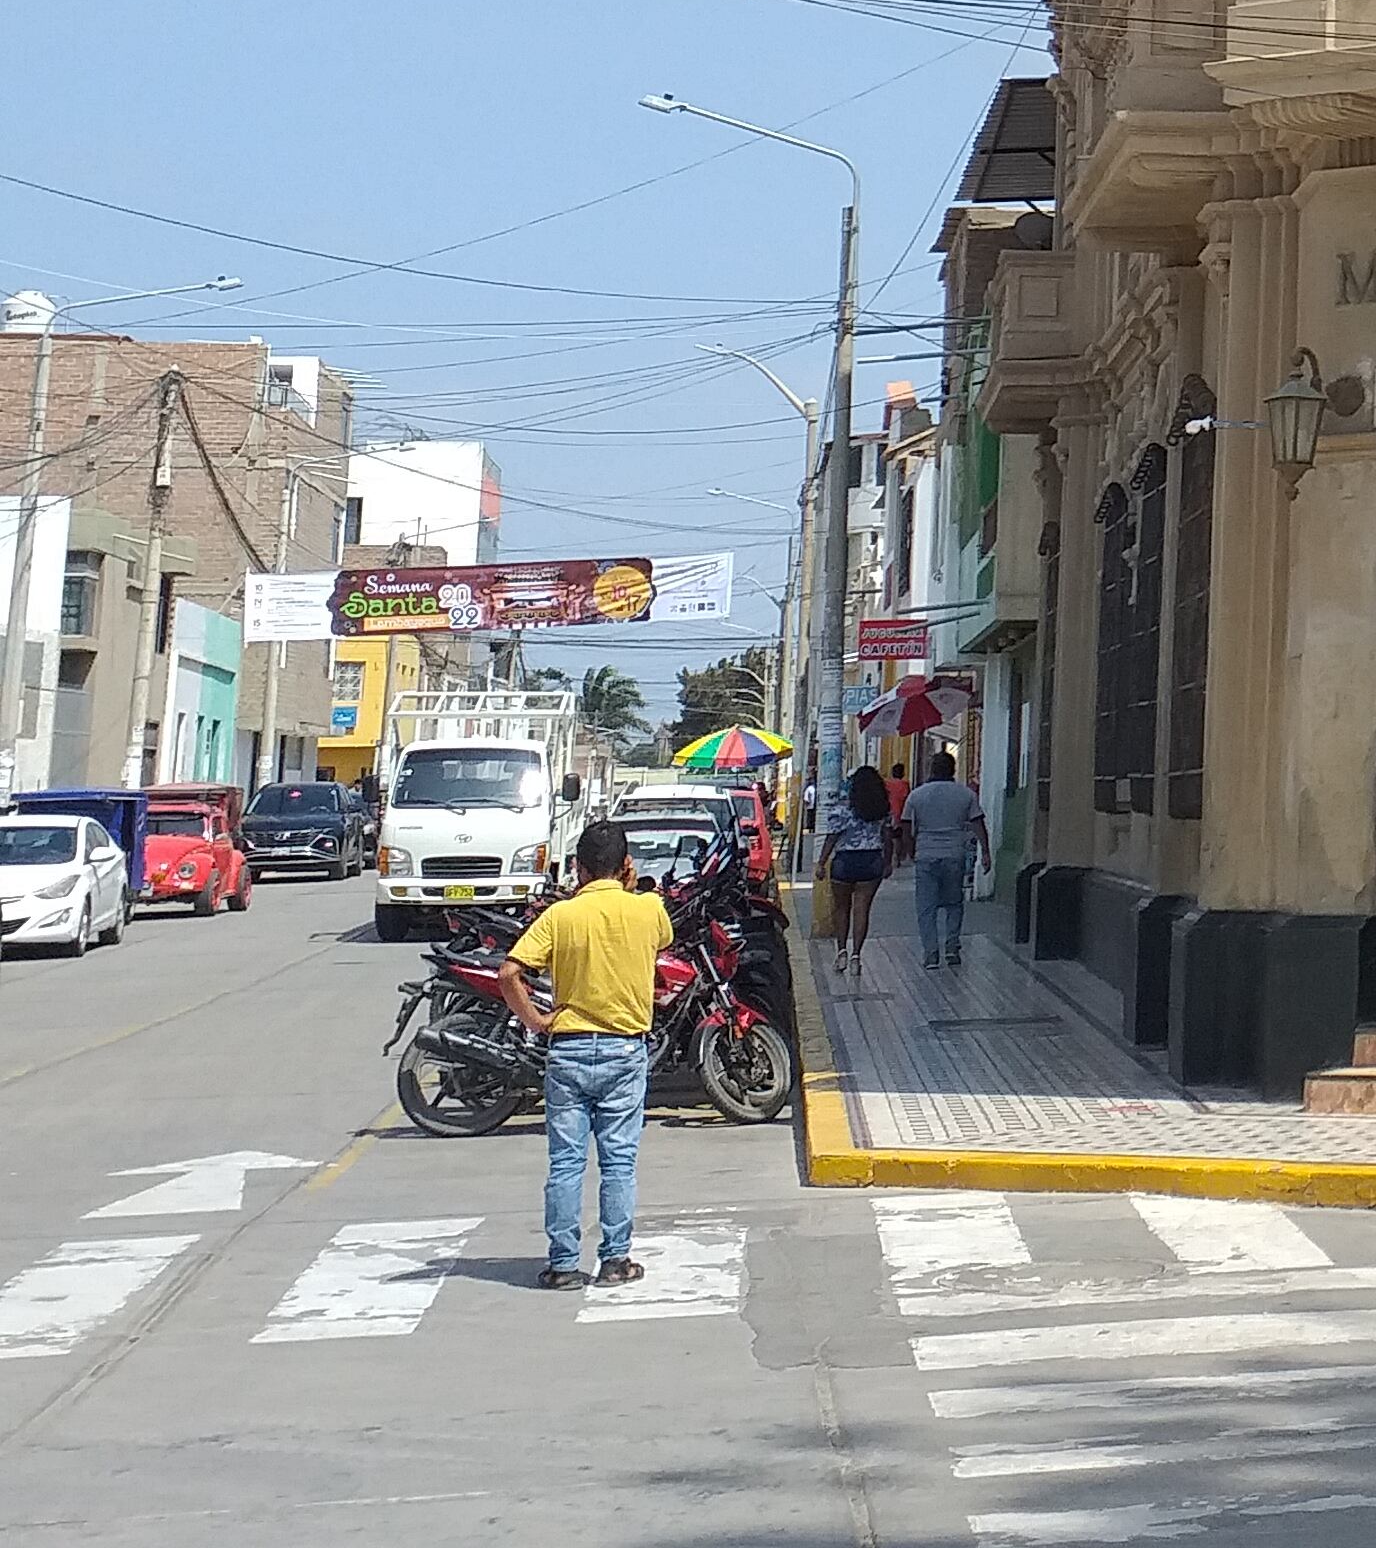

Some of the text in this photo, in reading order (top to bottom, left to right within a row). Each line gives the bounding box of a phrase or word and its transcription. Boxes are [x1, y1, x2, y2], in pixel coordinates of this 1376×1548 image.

[364, 575, 433, 594] Semana
[440, 584, 471, 607] 20
[340, 591, 439, 618] Santa
[450, 606, 481, 628] 22
[861, 641, 924, 656] CAFETÍN
